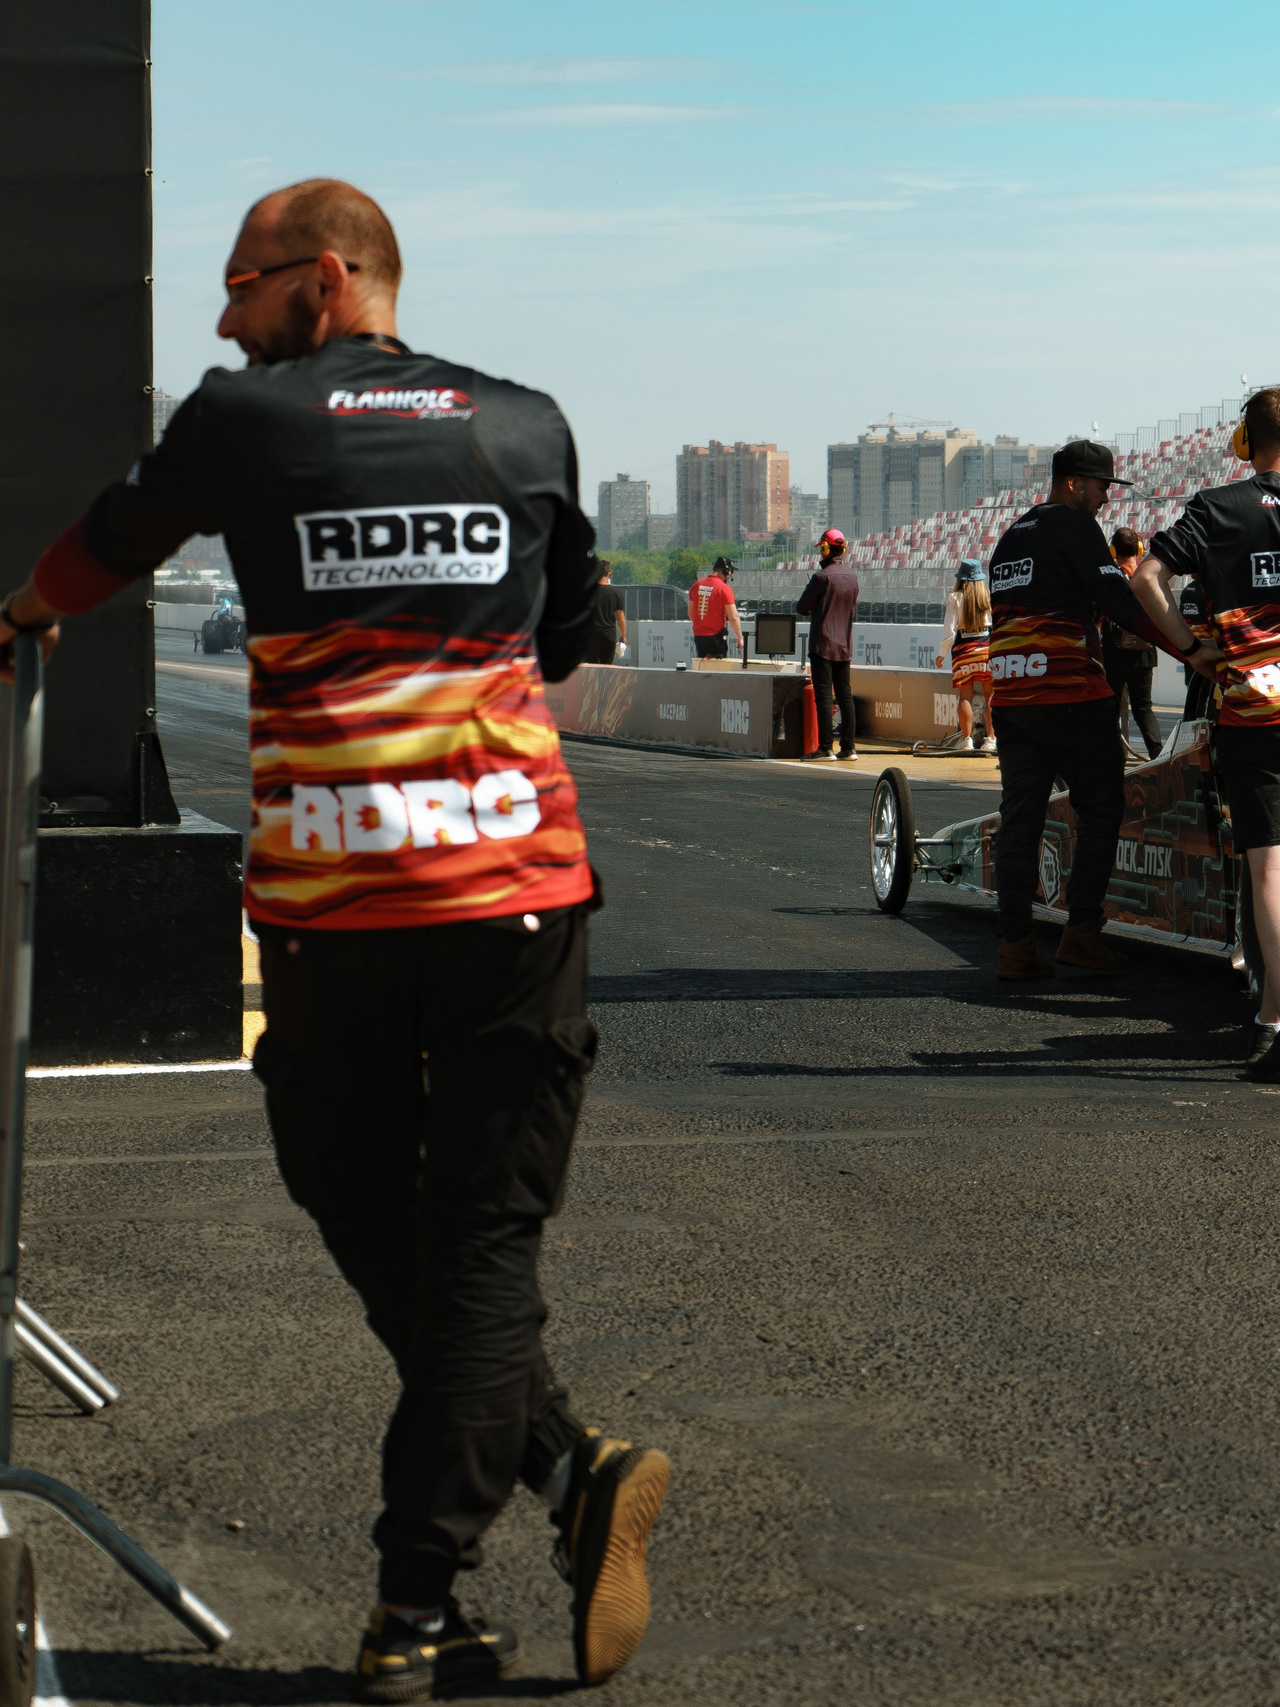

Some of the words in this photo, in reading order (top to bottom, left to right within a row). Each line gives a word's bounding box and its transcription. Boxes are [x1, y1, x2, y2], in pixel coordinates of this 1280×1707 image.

[304, 511, 500, 562] RDRC
[311, 561, 498, 586] TECHNOLOGY
[989, 653, 1048, 680] DRC
[721, 699, 750, 735] RDRC
[934, 693, 960, 726] RDR
[290, 769, 542, 853] RDRC
